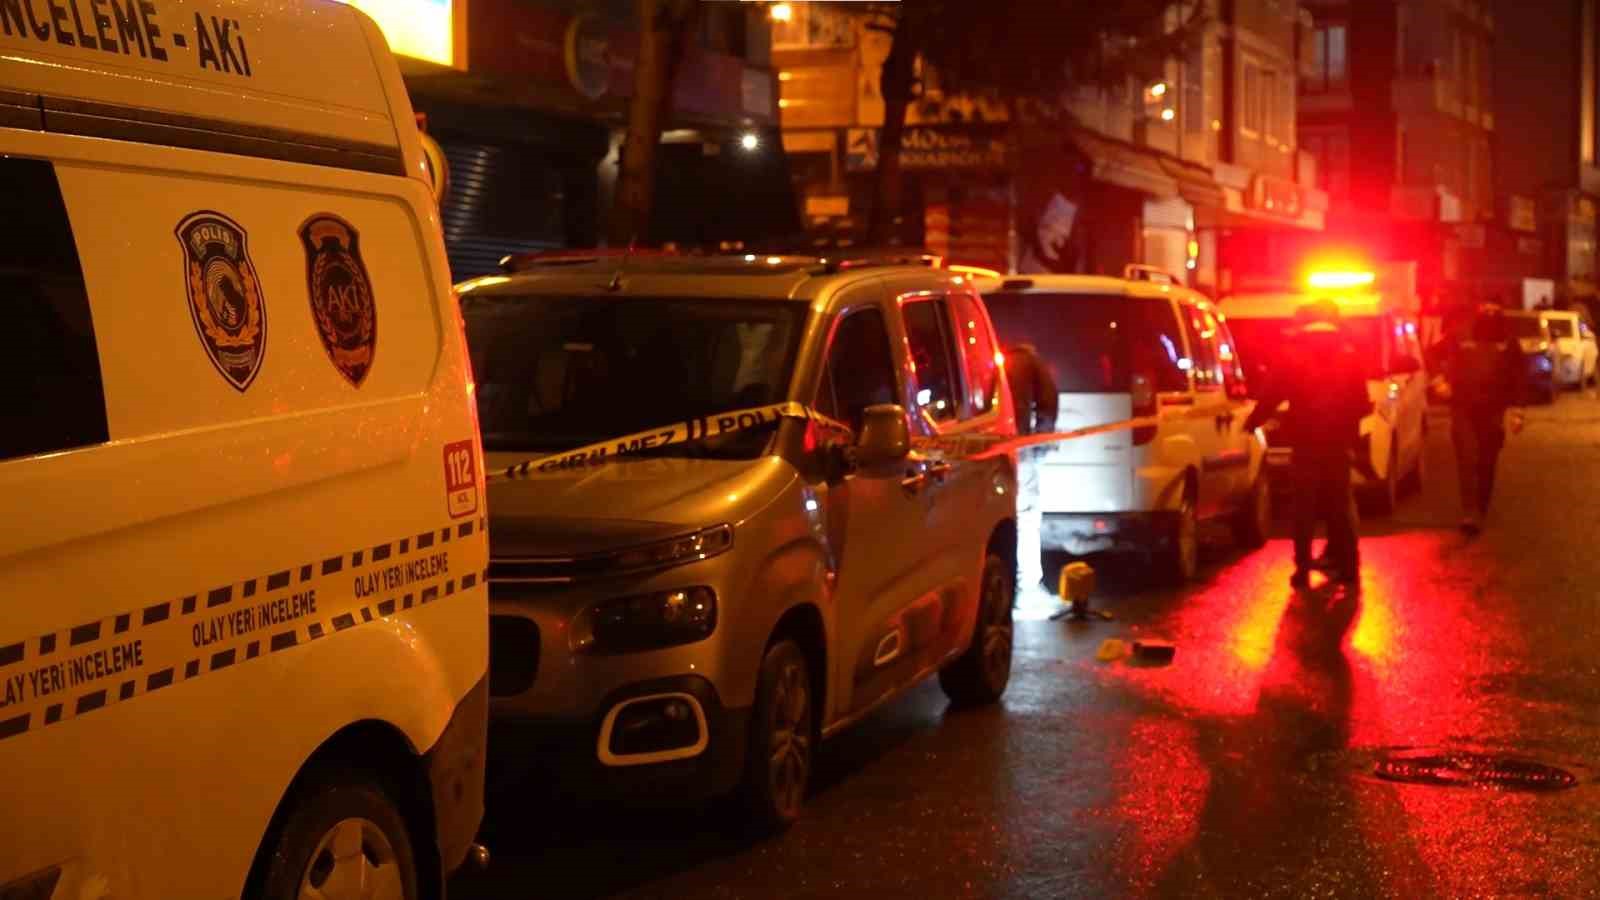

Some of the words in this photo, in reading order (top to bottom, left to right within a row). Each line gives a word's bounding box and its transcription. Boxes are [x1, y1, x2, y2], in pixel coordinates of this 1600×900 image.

[448, 449, 472, 487] 112
[354, 571, 380, 599] OLAY
[192, 615, 225, 648] OLAY
